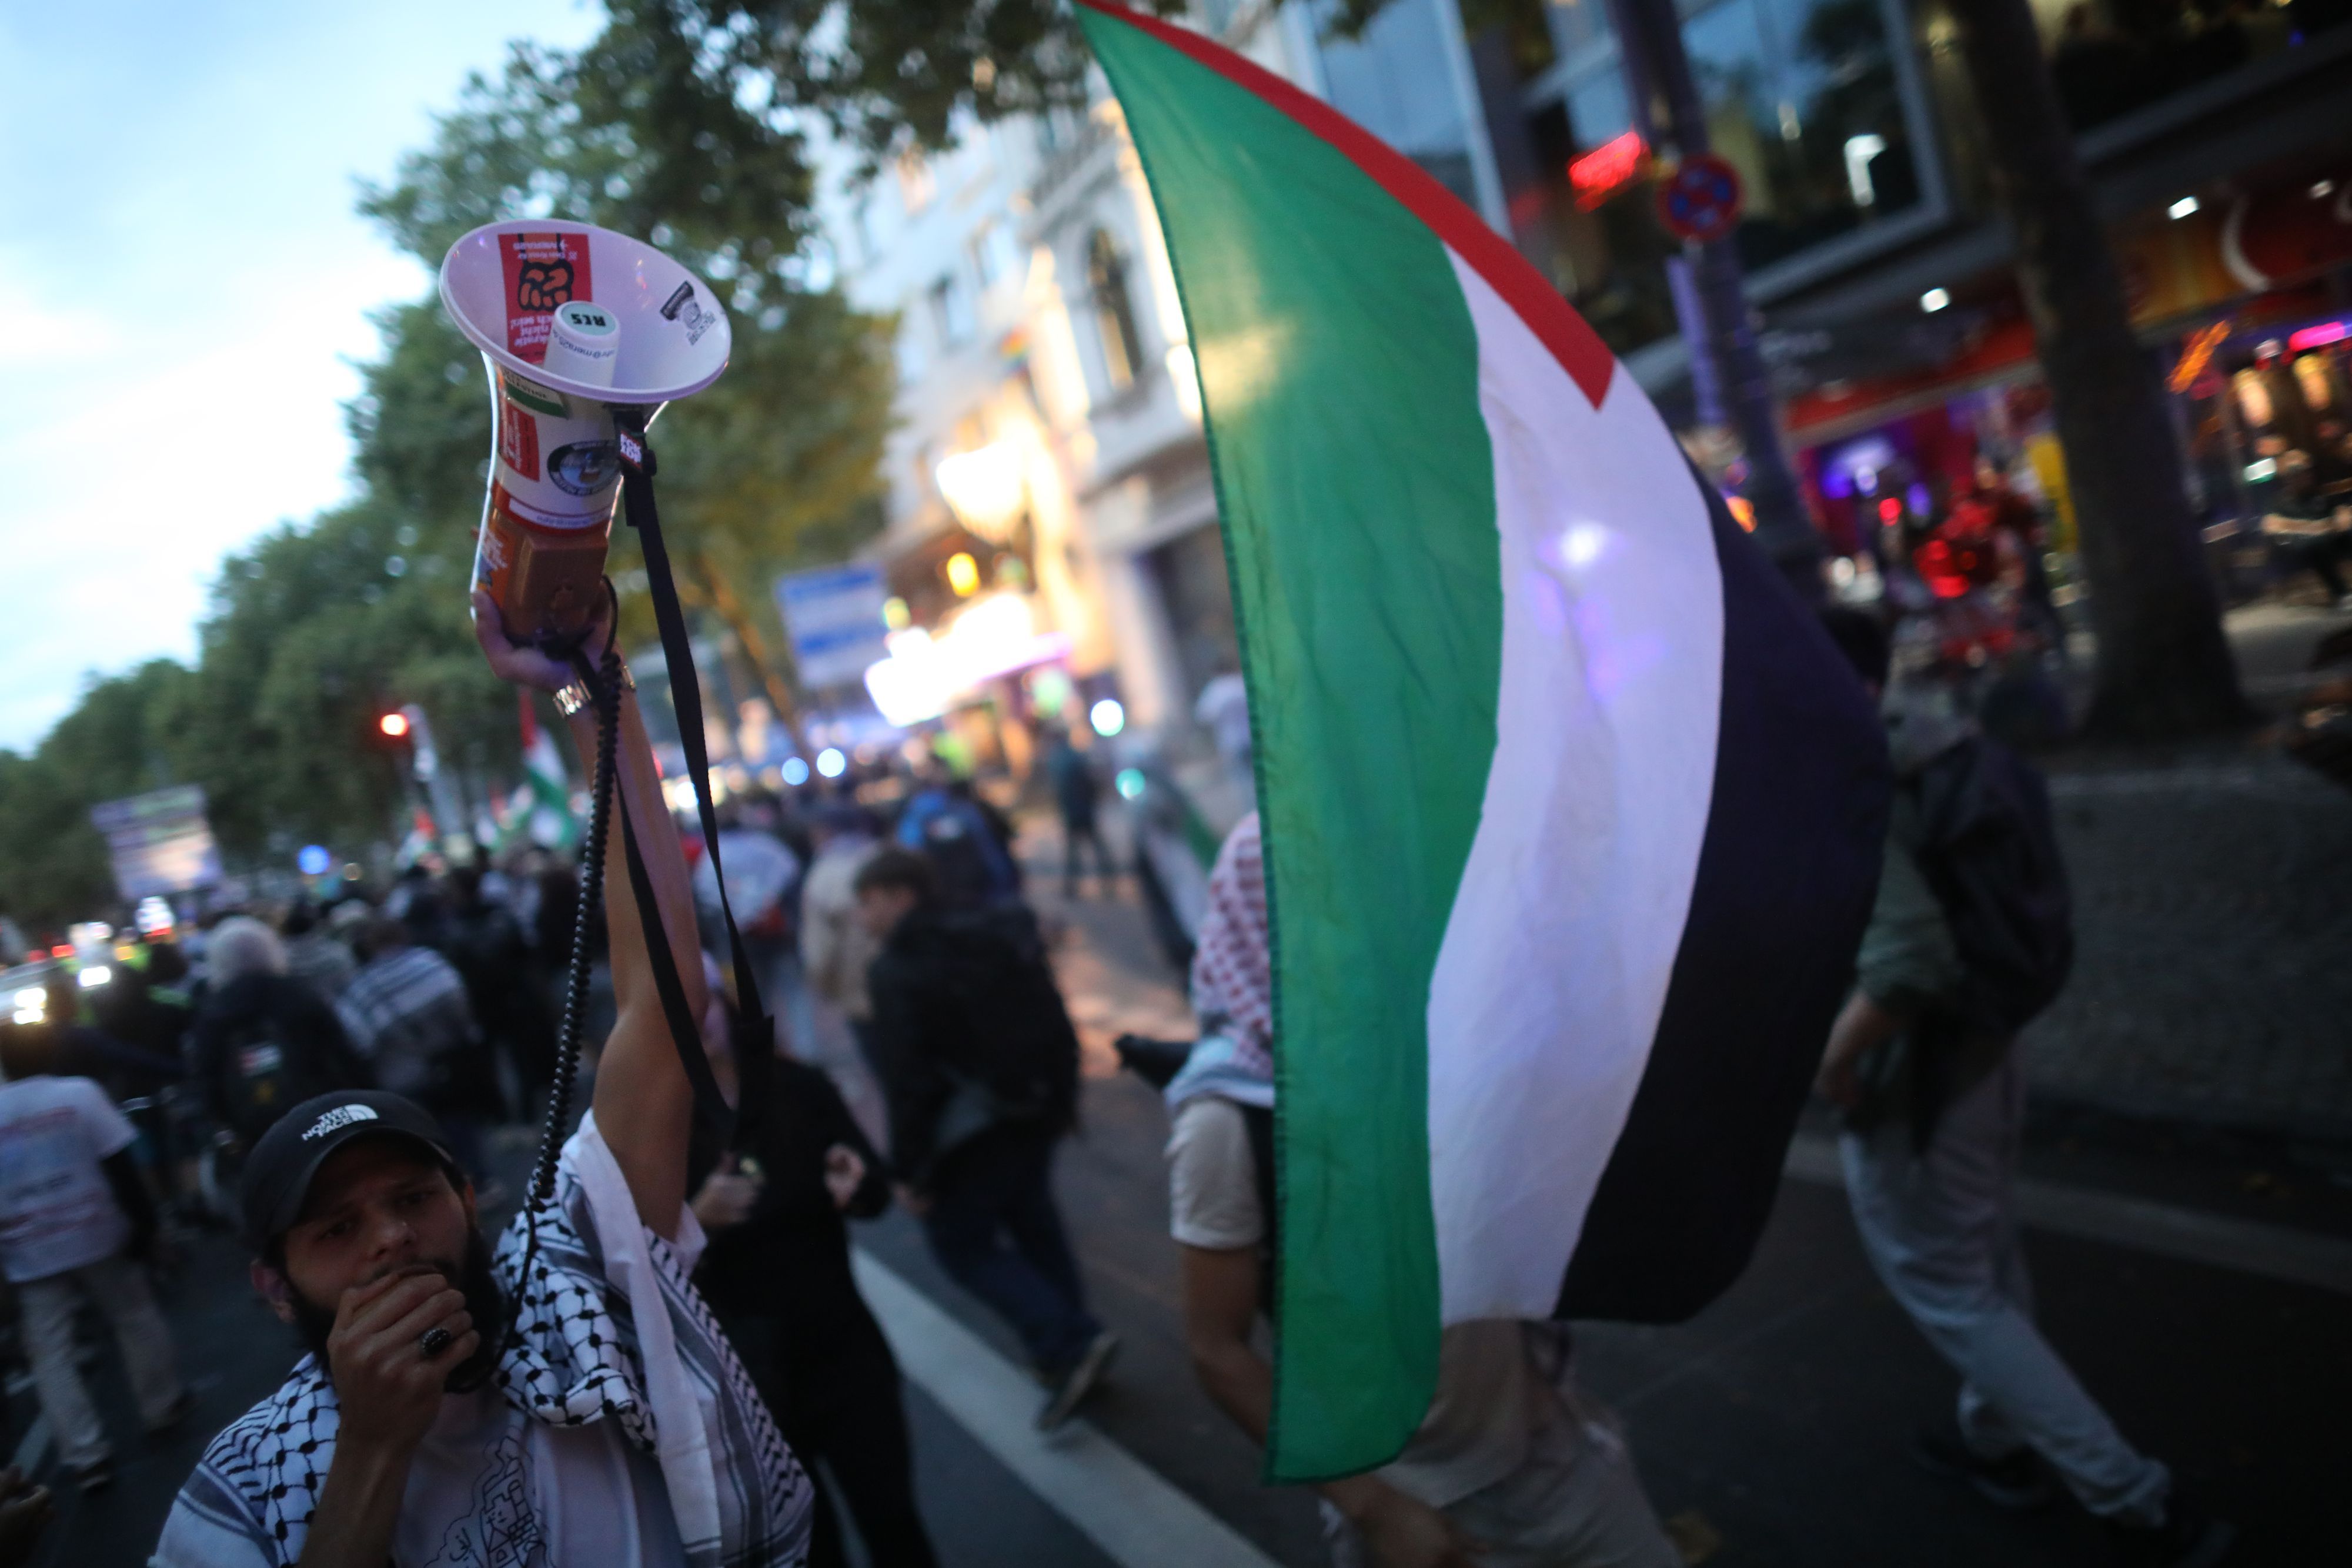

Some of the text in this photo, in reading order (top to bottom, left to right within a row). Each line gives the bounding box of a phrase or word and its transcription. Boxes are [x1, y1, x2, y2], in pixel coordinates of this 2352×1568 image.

[318, 1106, 346, 1119] THE
[301, 1112, 349, 1141] NORTH
[318, 1116, 353, 1138] FACE
